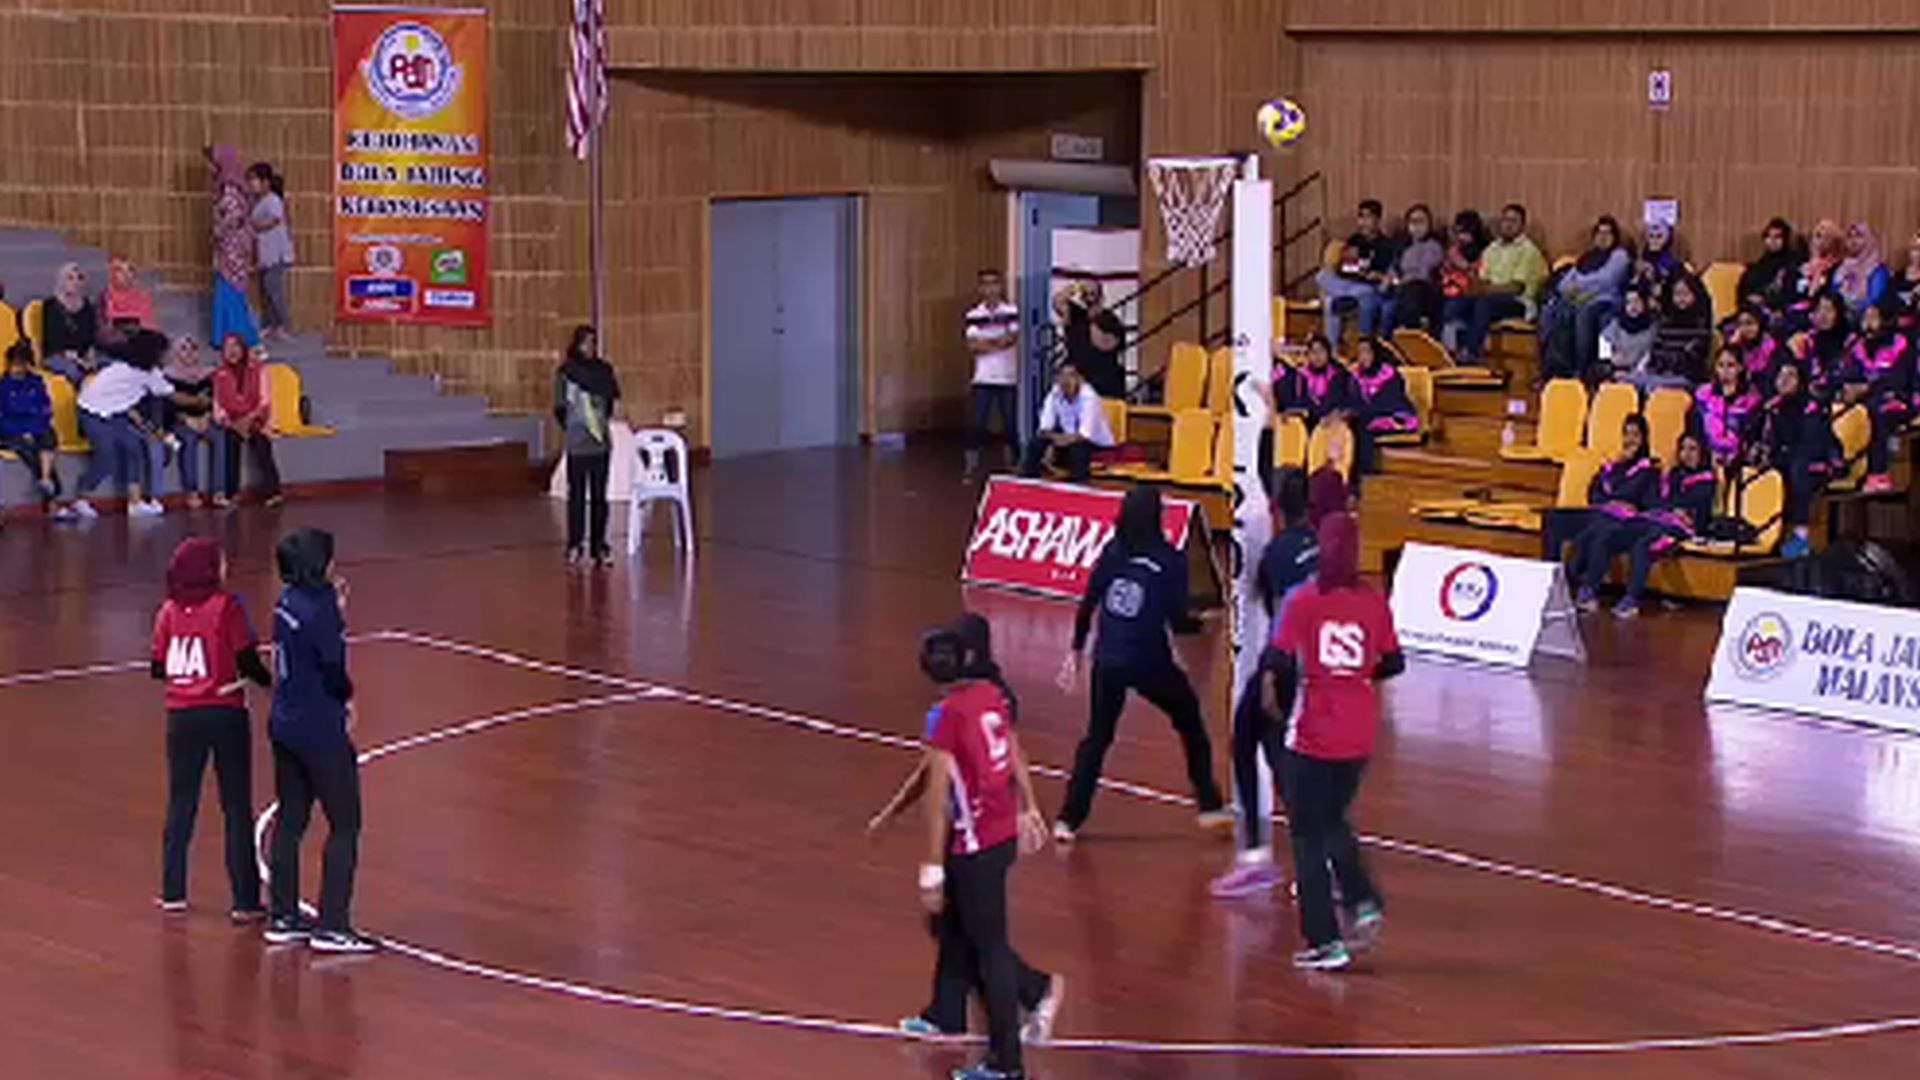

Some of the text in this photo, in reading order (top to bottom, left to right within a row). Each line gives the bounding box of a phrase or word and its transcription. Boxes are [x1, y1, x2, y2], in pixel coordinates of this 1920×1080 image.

[969, 508, 1118, 568] ASHAW
[1318, 620, 1366, 668] GS
[1802, 620, 1873, 663] BOLA
[1881, 634, 1920, 669] JA
